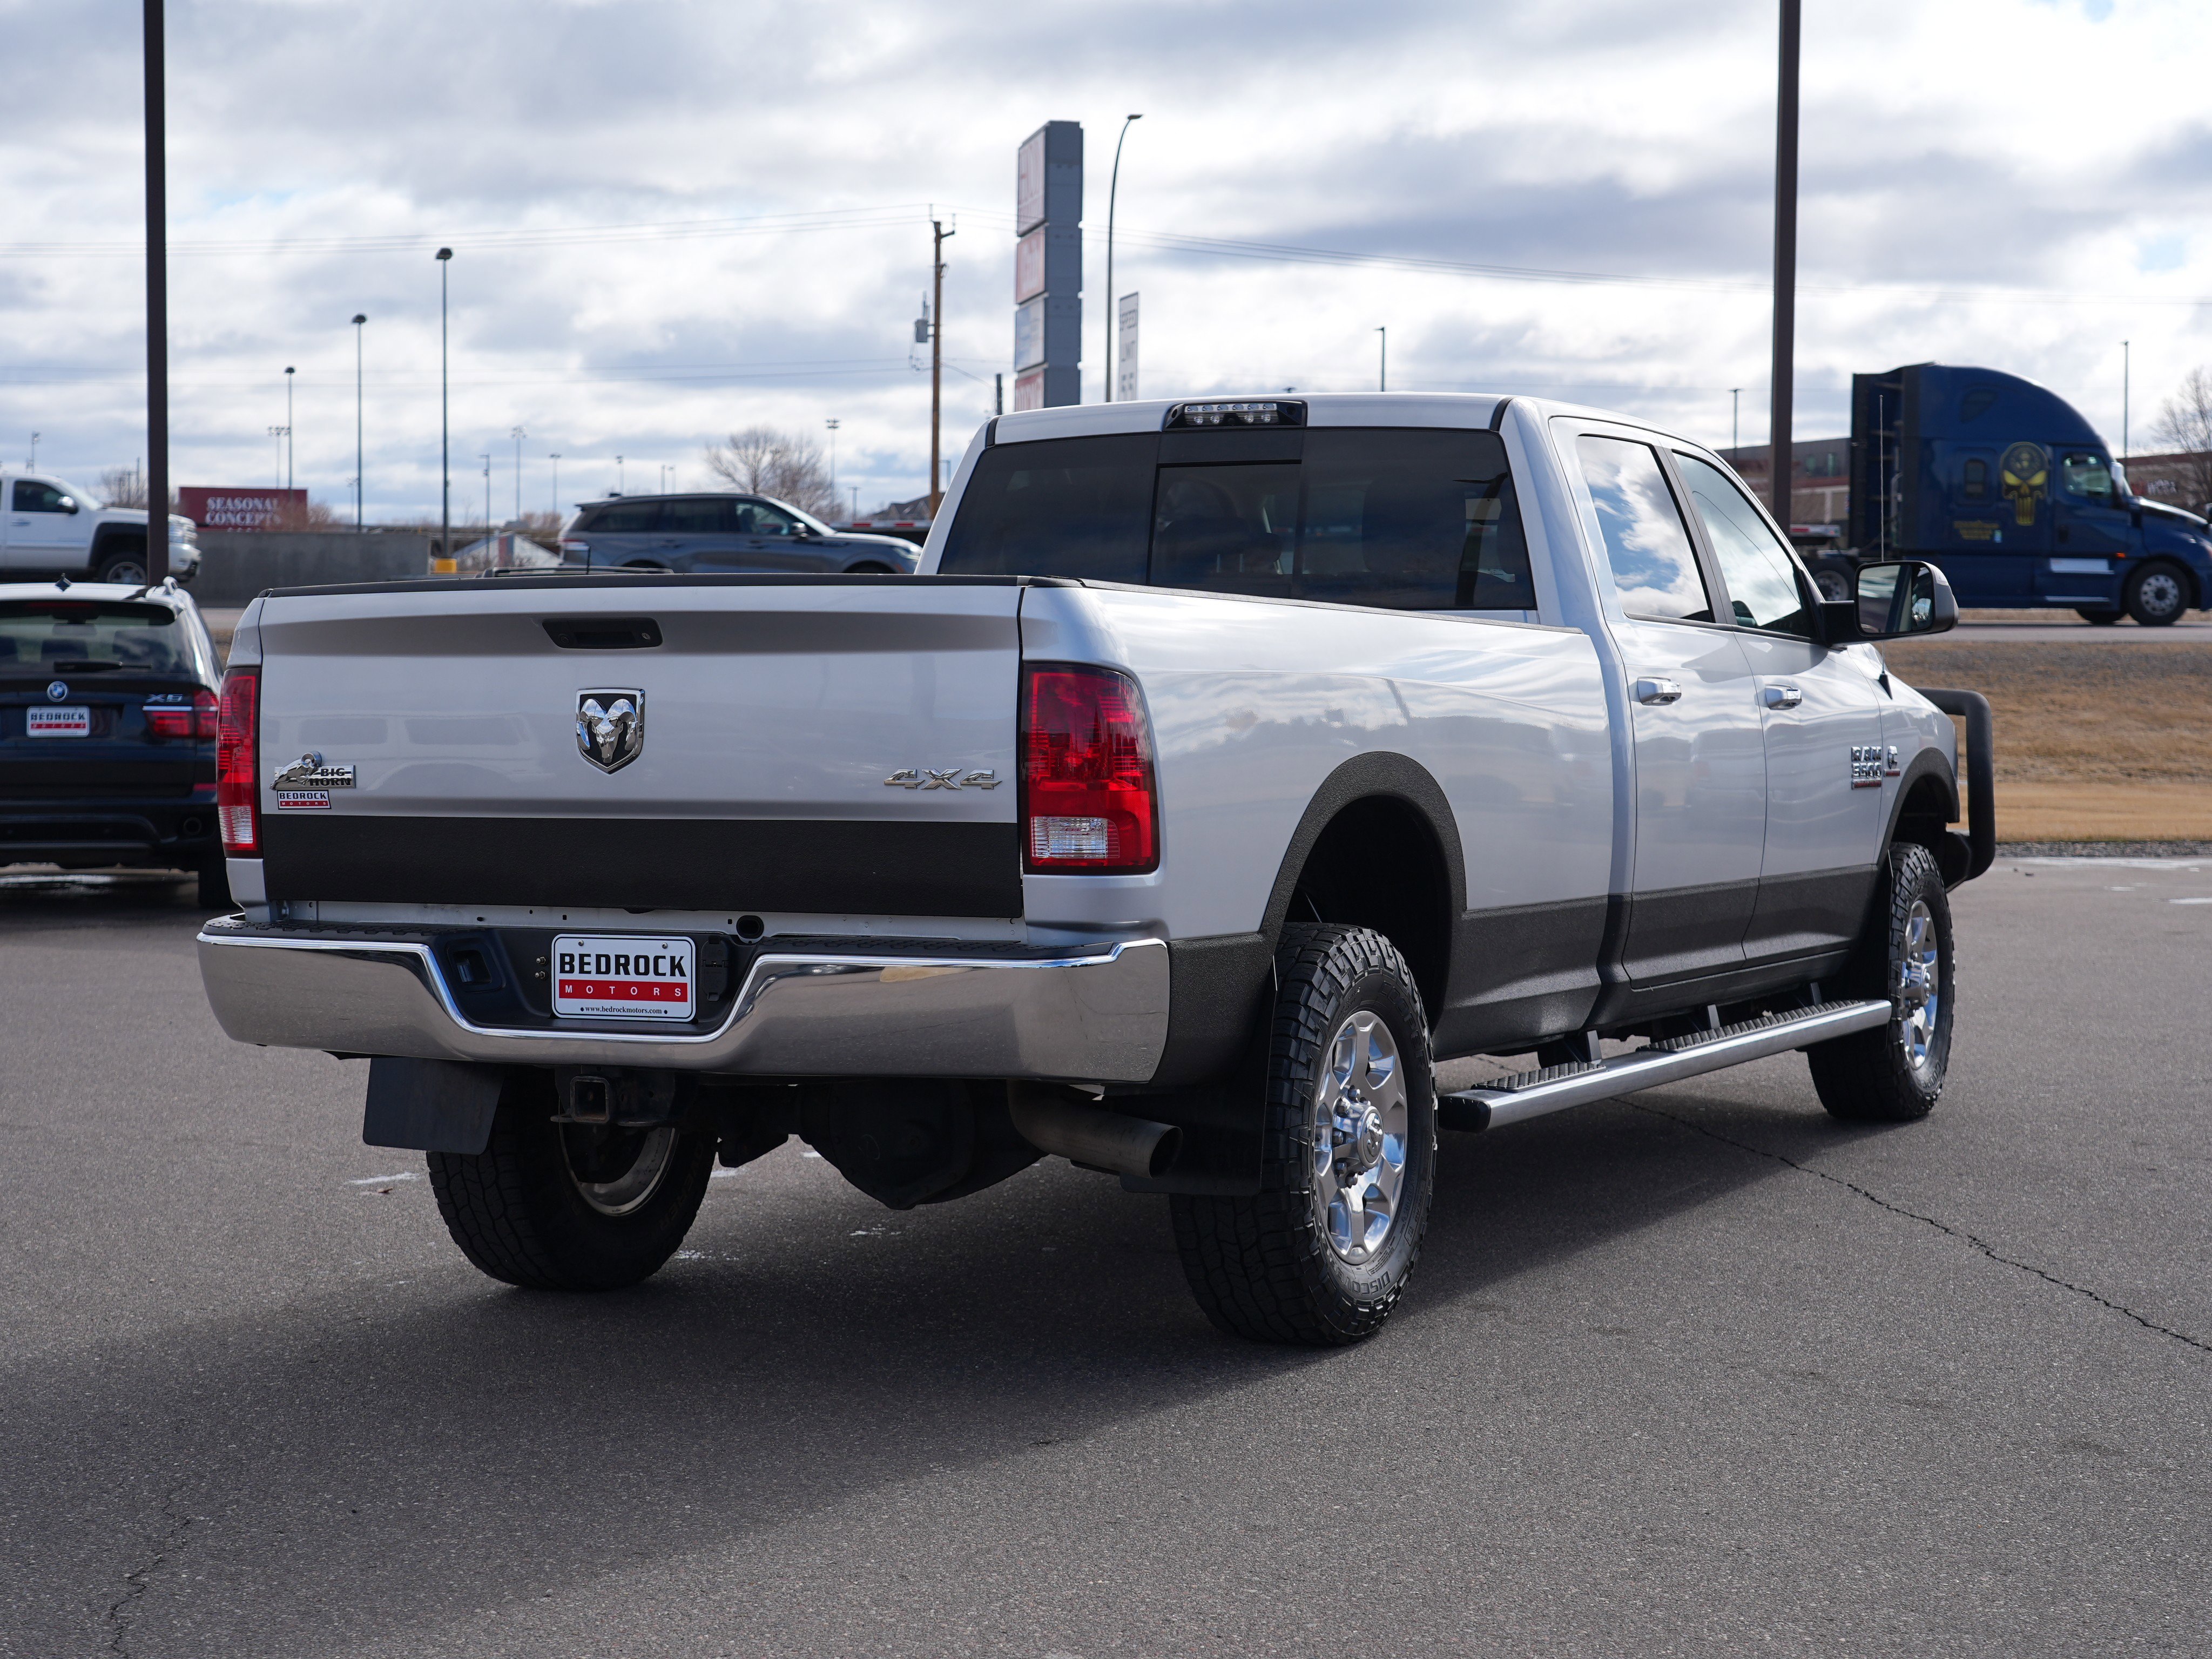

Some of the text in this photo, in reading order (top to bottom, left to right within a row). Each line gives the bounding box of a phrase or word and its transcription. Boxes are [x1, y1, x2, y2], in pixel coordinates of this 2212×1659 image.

[206, 496, 279, 511] SEASONAL
[205, 511, 282, 526] CONCEPTS
[145, 693, 183, 703] X5
[31, 712, 85, 720] BEDROCK
[321, 768, 345, 777] BIG
[309, 778, 352, 786] HORN
[884, 768, 1003, 790] 4X4
[559, 953, 687, 977] BEDROCK
[565, 985, 682, 997] MOTORS
[585, 1006, 663, 1015] www.bedrockmotors.com
[1379, 980, 1426, 1070] COOPER
